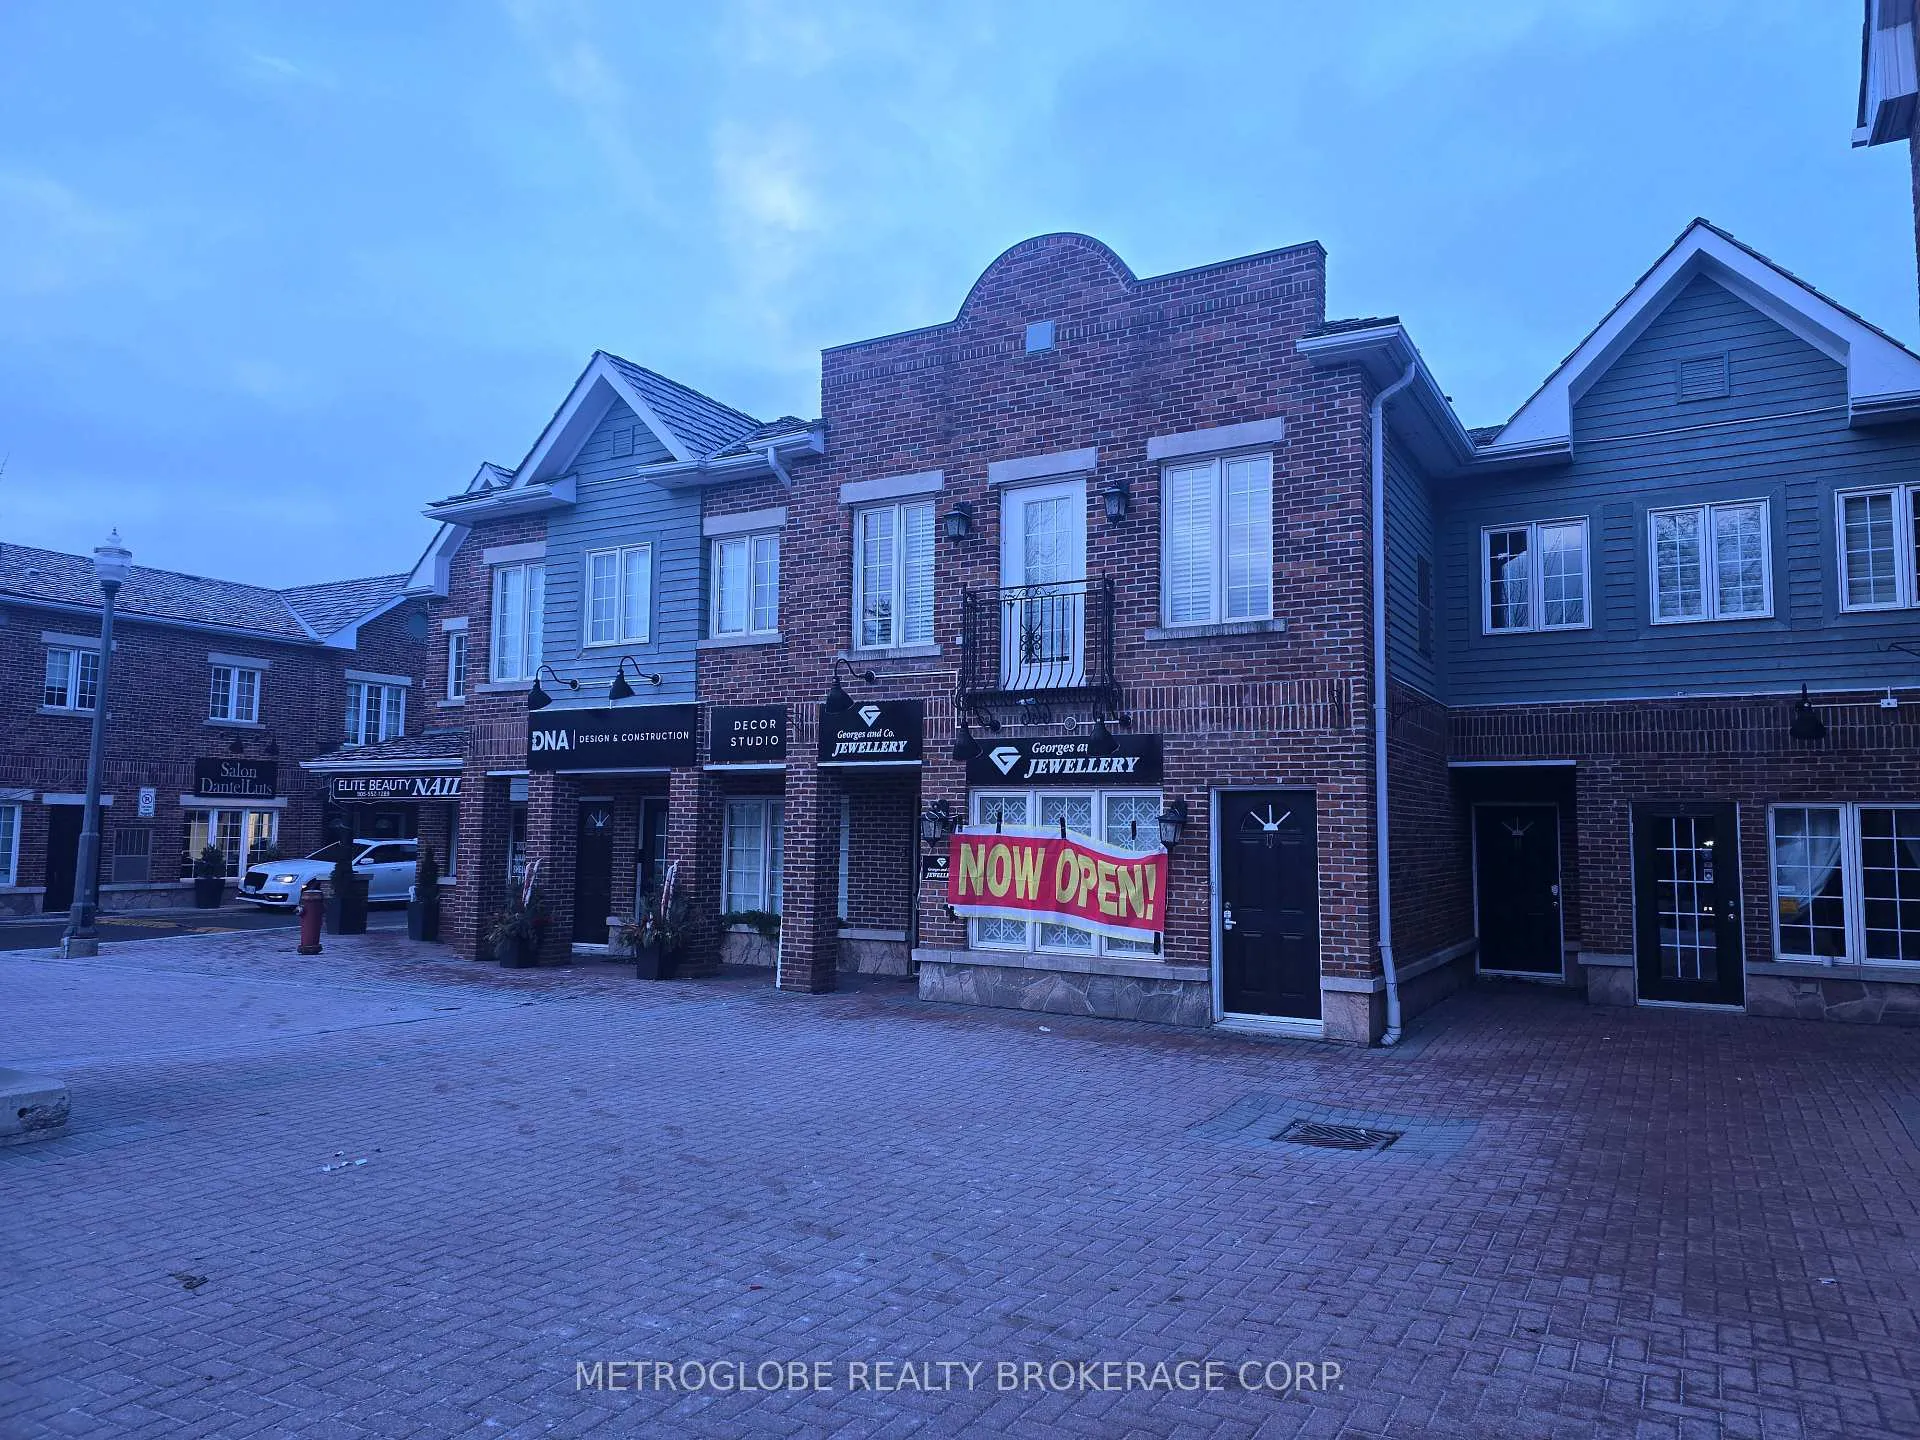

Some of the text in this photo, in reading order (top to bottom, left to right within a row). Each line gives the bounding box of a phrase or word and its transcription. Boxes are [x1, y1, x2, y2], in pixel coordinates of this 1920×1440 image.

[733, 719, 777, 731] DECOR
[531, 729, 570, 751] DNA
[579, 731, 689, 743] DESIGN & CONSTRUCTION
[730, 735, 779, 747] STUDIO
[837, 728, 895, 740] Georges and Co.
[831, 740, 908, 757] JEWELLERY
[1031, 742, 1075, 756] Georges
[220, 761, 257, 778] Salon
[1023, 757, 1140, 779] JEWELLERY
[338, 780, 366, 791] ELITE
[368, 779, 411, 791] BEAUTY
[958, 843, 1157, 921] NOW OPEN!
